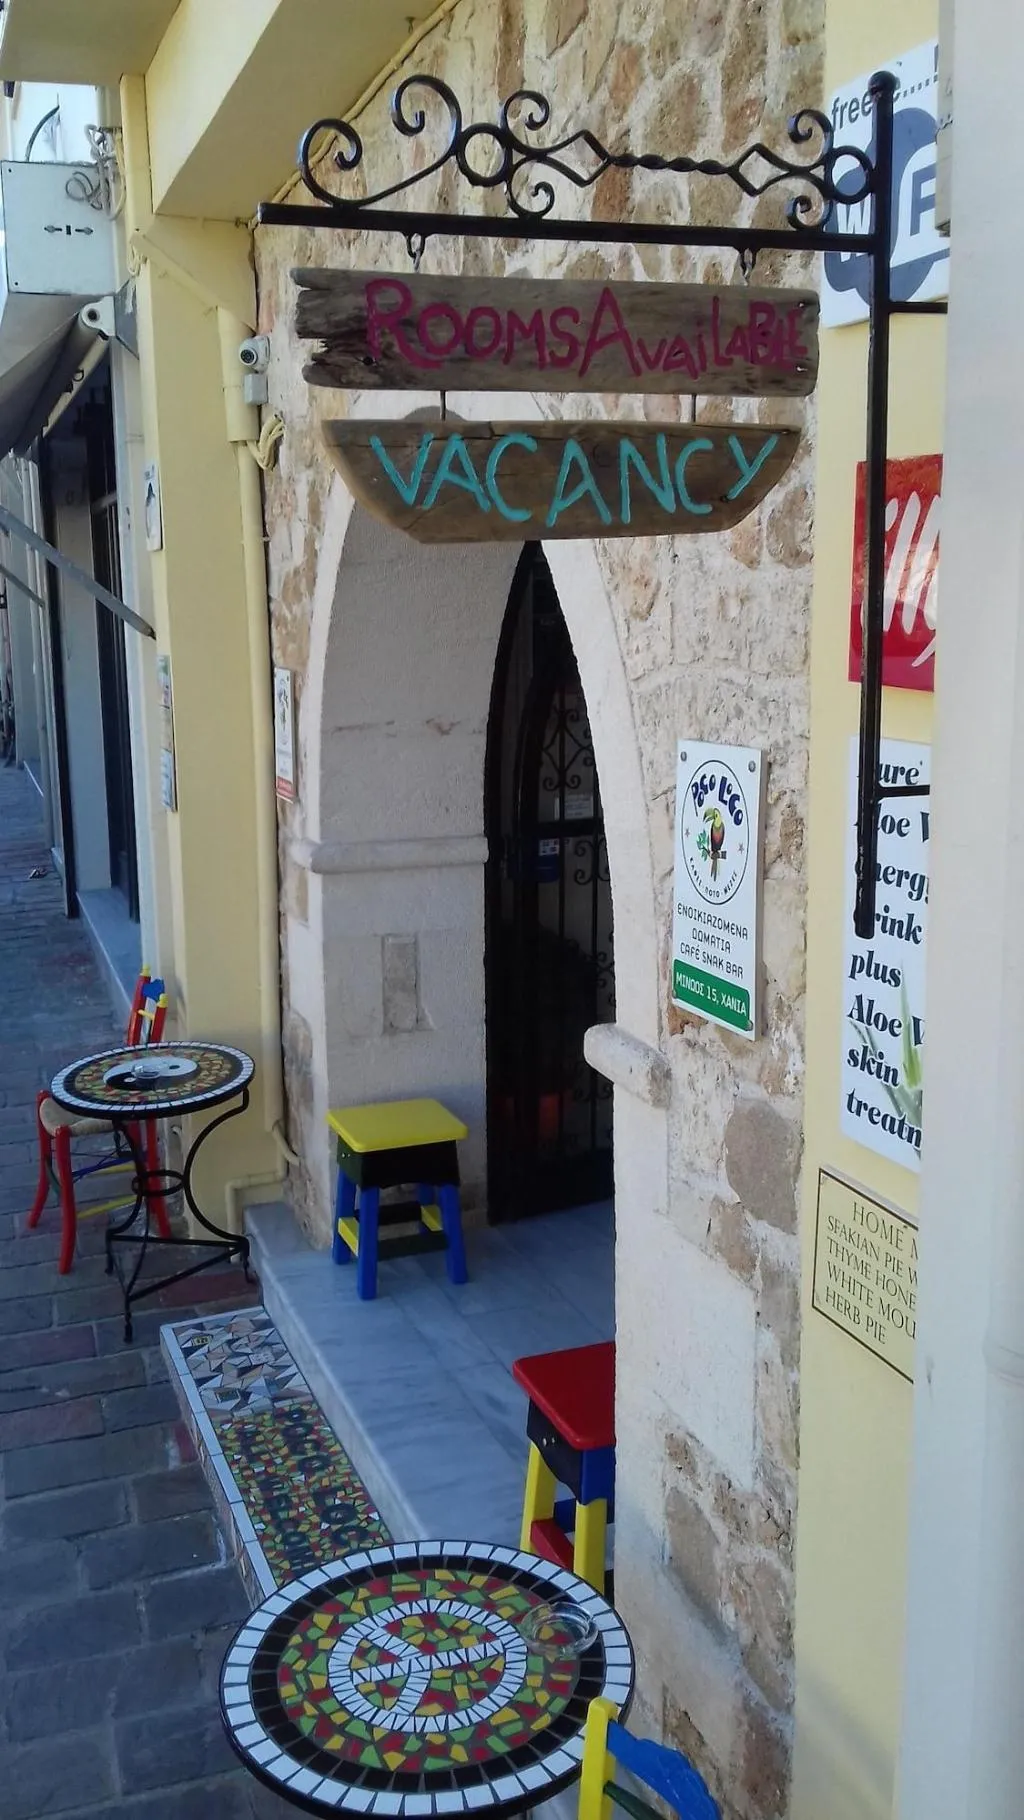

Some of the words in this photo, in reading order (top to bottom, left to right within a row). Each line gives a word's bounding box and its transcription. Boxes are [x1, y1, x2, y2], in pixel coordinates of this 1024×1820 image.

[369, 431, 780, 527] VACANCY
[680, 942, 700, 960] CAFÉ
[702, 951, 724, 971] SNAK
[726, 961, 744, 979] BAR
[848, 950, 902, 988] plus
[847, 993, 902, 1038] Aloe
[847, 1045, 900, 1087] skin
[827, 1215, 881, 1262] SFAKIAN
[885, 1252, 904, 1279] PIE
[853, 1201, 904, 1252] HOME
[827, 1236, 871, 1281] THYME
[875, 1268, 917, 1312] HONE
[827, 1260, 874, 1309] WHITE
[825, 1286, 861, 1326] HERB
[865, 1317, 887, 1345] PIE
